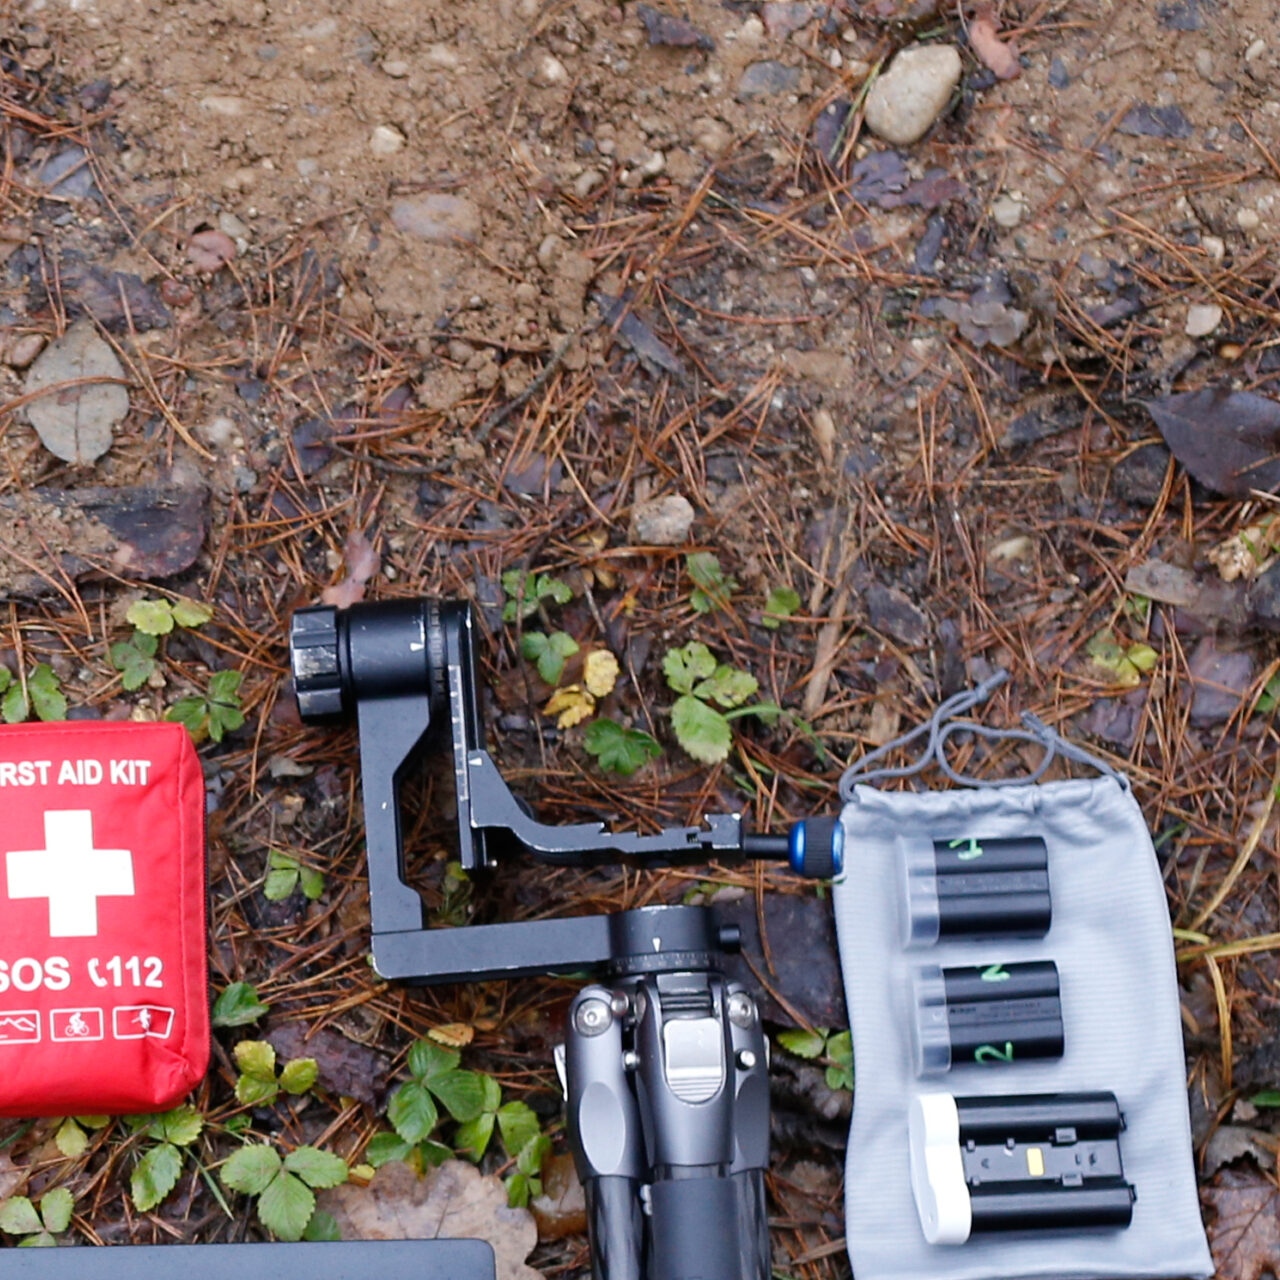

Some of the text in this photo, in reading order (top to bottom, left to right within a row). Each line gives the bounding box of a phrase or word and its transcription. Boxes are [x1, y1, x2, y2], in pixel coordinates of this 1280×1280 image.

[58, 759, 103, 785] AID
[109, 759, 151, 786] KIT
[106, 956, 163, 988] 112
